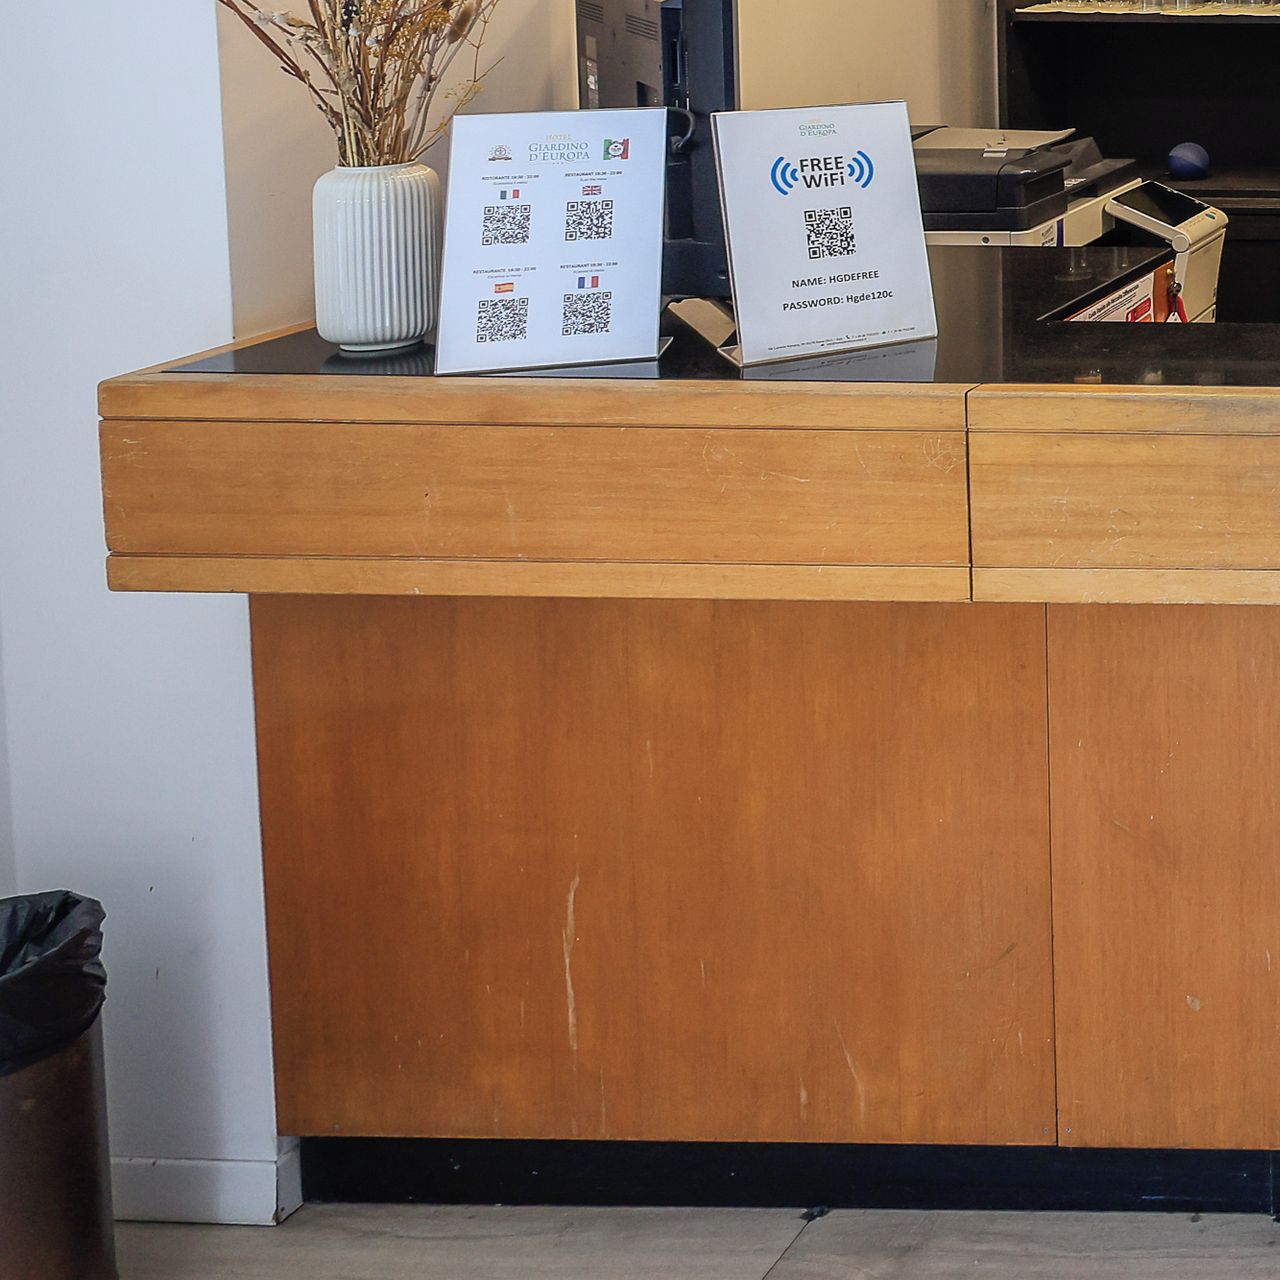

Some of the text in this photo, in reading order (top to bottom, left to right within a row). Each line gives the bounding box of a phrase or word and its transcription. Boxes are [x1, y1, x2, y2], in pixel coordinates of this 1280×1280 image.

[799, 123, 835, 131] GIARDINO
[528, 141, 589, 152] GIARDINO
[528, 150, 590, 162] D'EUROPA
[799, 155, 845, 173] FREE
[802, 171, 846, 189] WiFi
[791, 270, 880, 289] NAME: HGDEFREE
[782, 290, 894, 311] PASSWORD: Hgde120c
